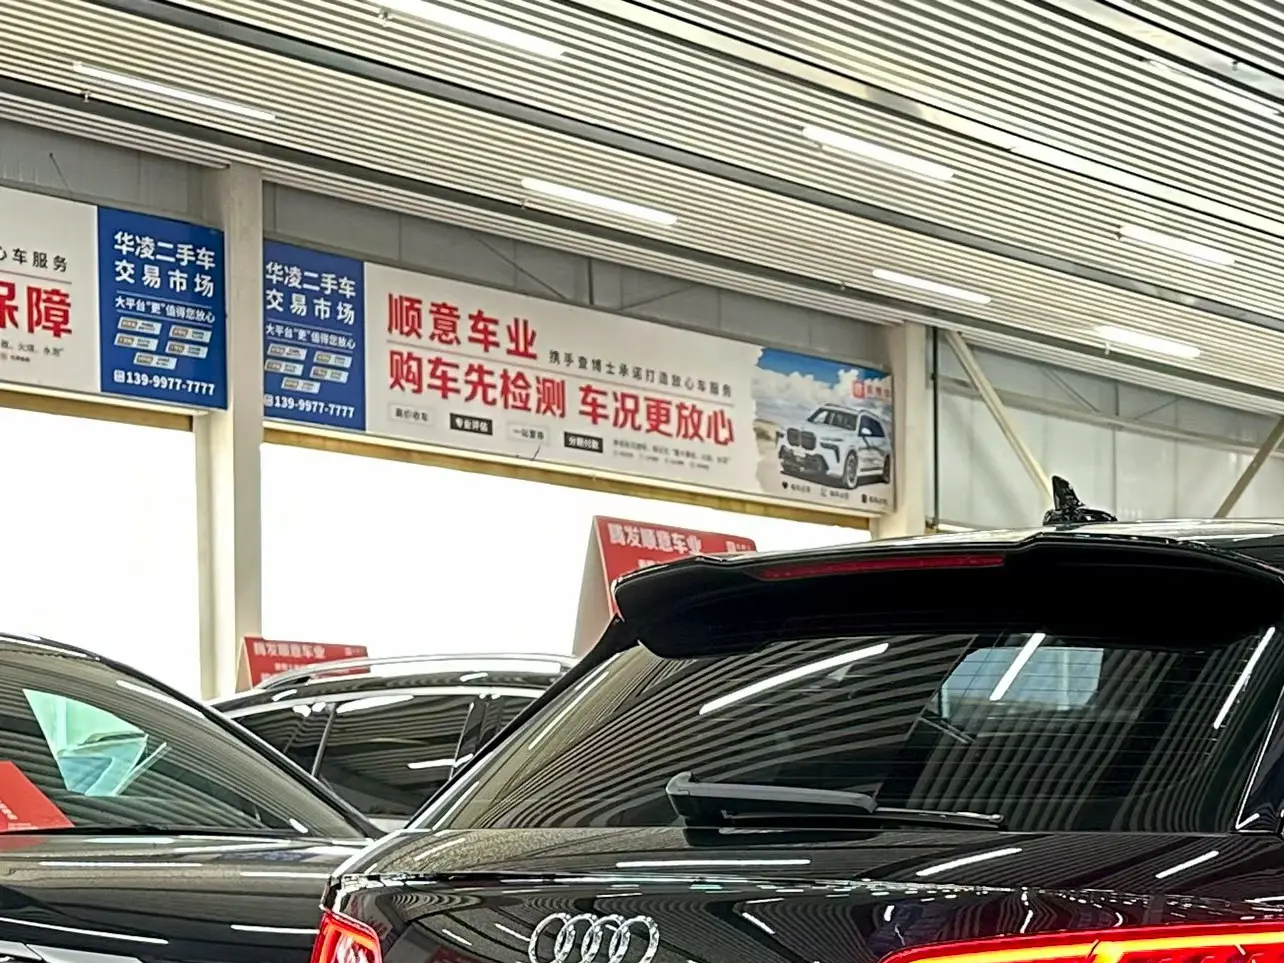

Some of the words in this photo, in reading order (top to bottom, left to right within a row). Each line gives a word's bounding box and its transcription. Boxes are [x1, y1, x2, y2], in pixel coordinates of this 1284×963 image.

[114, 231, 216, 271] 华凌二手车
[114, 259, 215, 298] 交易市场
[265, 261, 357, 299] 华凌二手车
[265, 288, 356, 325] 交易市场
[387, 293, 538, 361] 顺意车业
[389, 349, 568, 419] 购车先检测
[578, 384, 735, 447] 车况更放心
